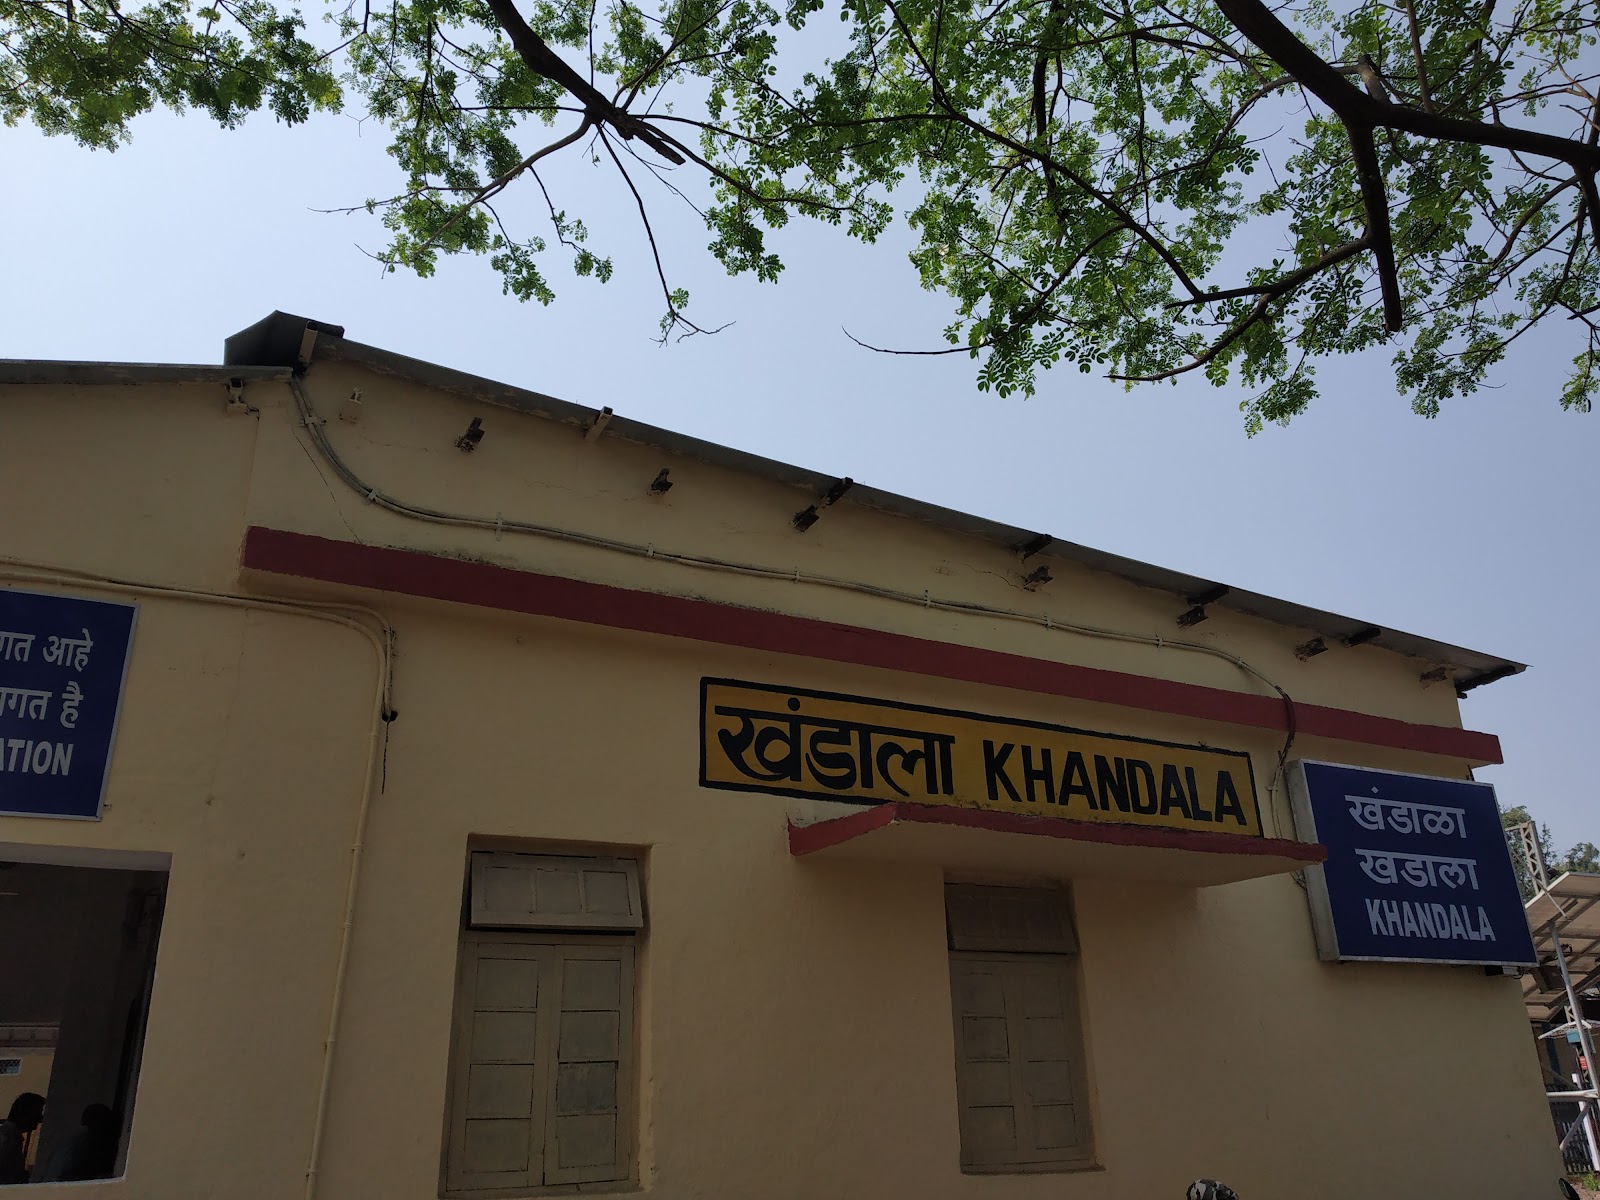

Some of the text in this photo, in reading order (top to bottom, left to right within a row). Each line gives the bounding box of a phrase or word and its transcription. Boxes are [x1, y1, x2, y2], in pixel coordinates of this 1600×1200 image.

[43, 628, 93, 672] आहे
[60, 681, 84, 728] है
[715, 697, 1247, 825] खंडाला KHANDALA
[1345, 786, 1467, 838] खंडाळा
[1355, 848, 1479, 890] खडाला
[1365, 898, 1496, 941] KHANDALA
